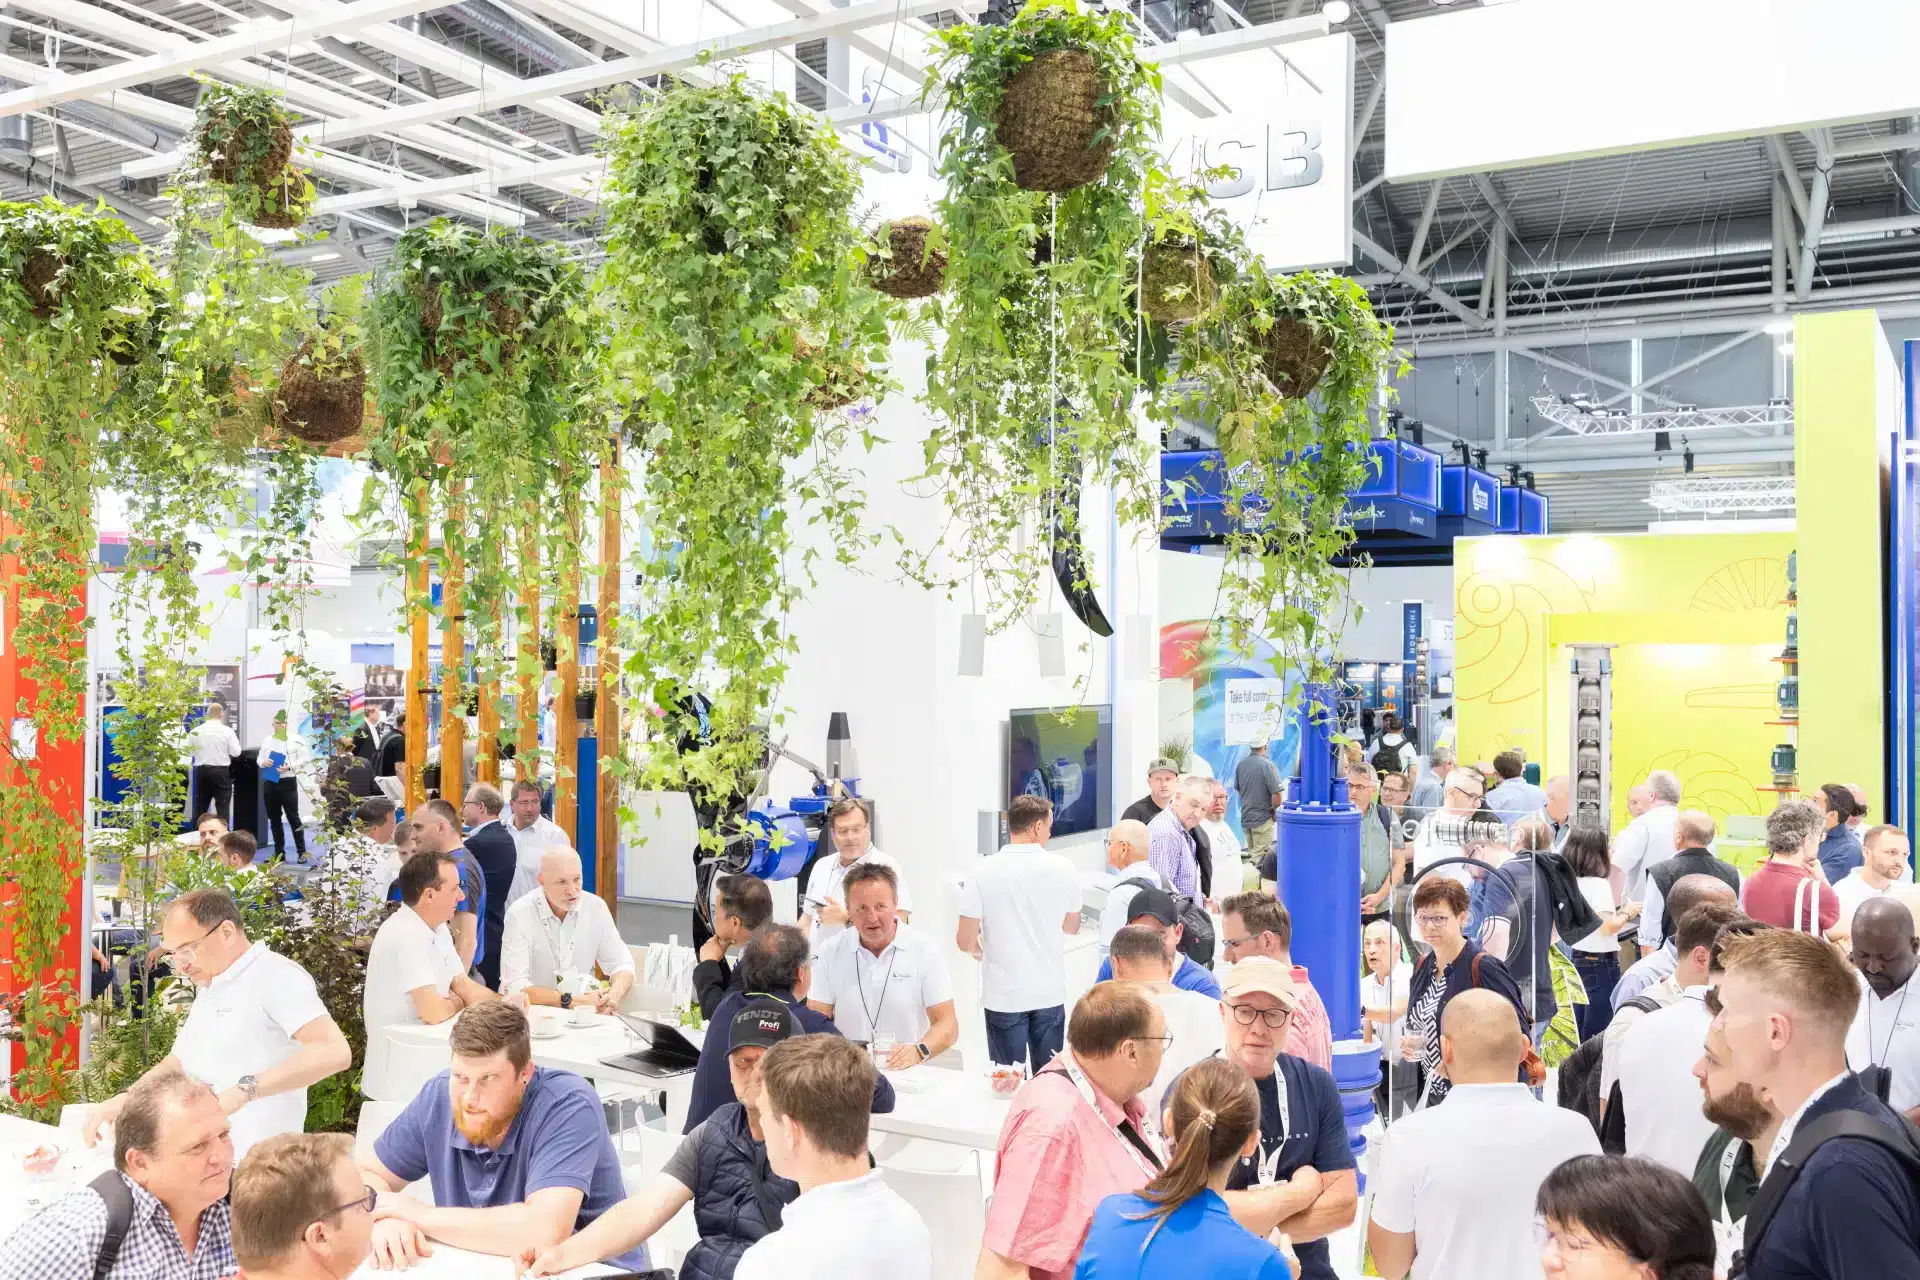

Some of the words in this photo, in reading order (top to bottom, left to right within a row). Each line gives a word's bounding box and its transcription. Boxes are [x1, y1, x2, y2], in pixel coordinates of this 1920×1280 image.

[1166, 119, 1325, 199] SB
[1229, 690, 1243, 703] Take
[737, 1010, 782, 1024] FENDT
[759, 1019, 780, 1030] Profi
